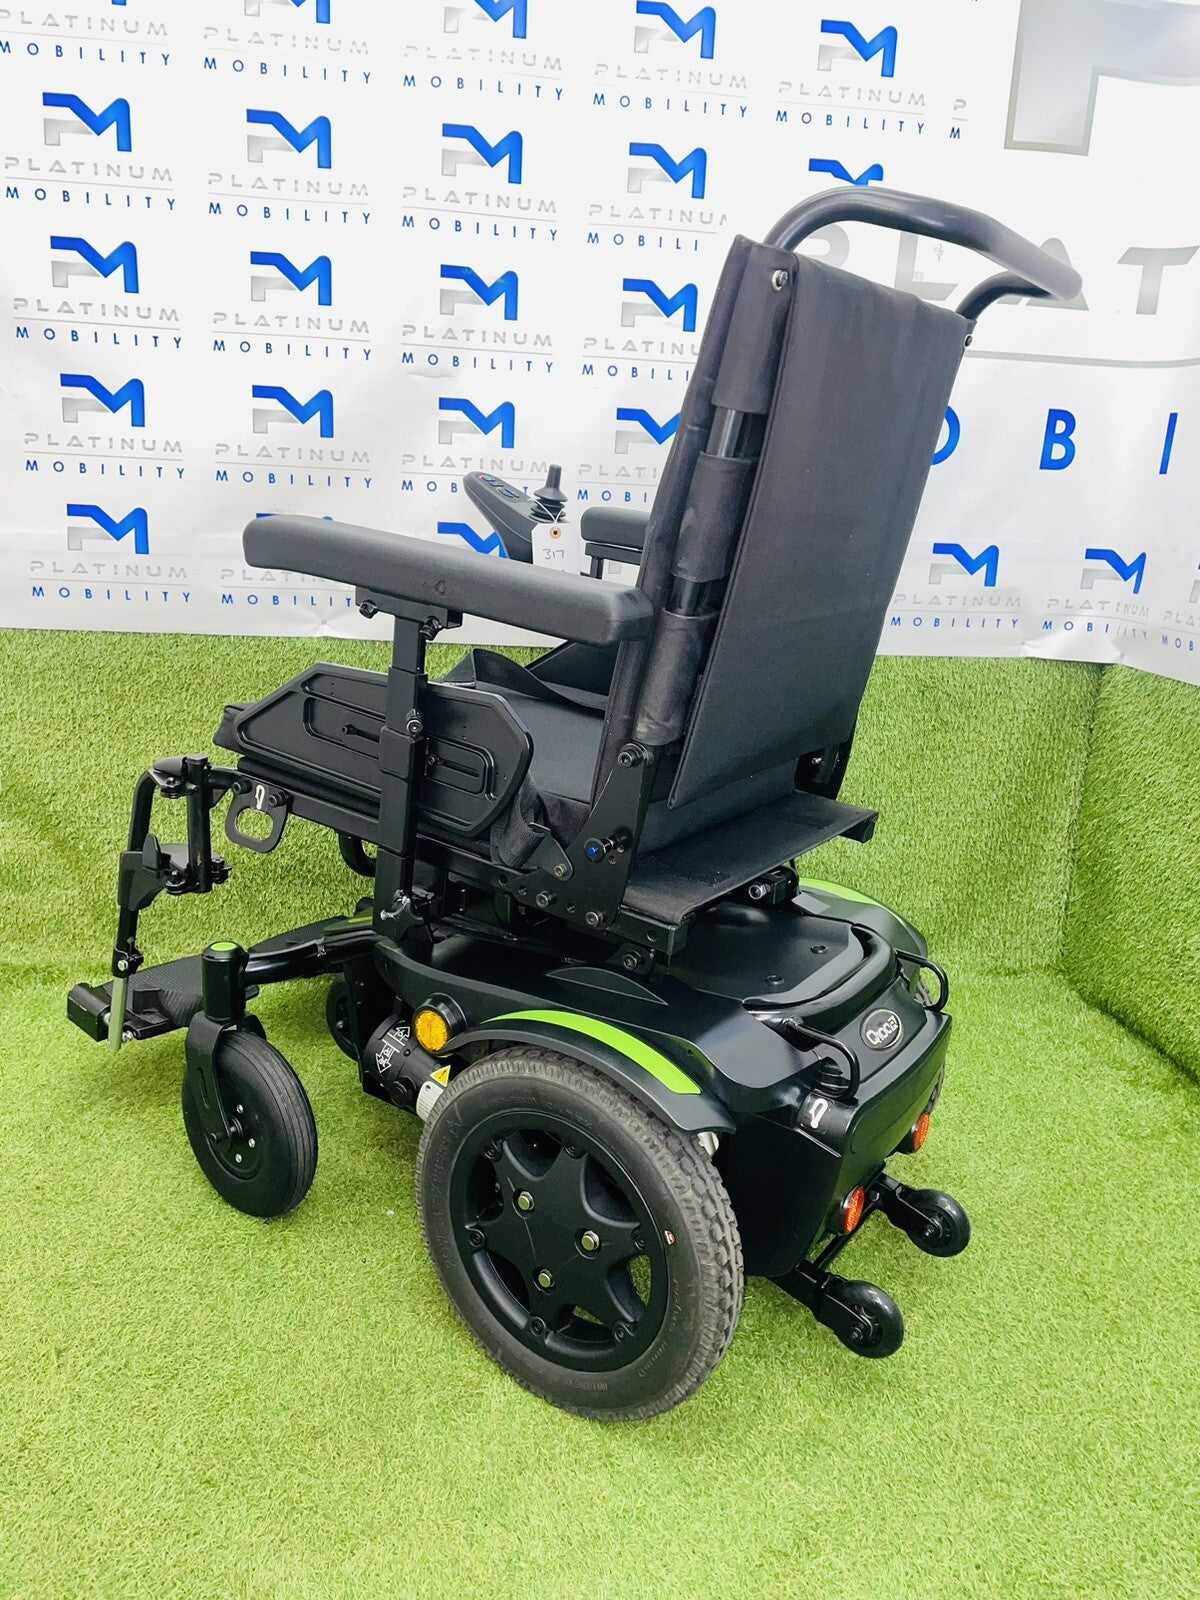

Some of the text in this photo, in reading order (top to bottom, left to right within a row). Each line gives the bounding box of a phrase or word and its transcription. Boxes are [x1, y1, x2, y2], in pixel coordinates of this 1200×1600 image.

[0, 9, 168, 36] PLATINUM
[203, 27, 370, 54] PLATINUM
[0, 41, 169, 66] MOBILITY
[404, 46, 562, 70] PLATINUM
[203, 57, 371, 84] MOBILITY
[595, 63, 747, 89] PLATINUM
[403, 75, 563, 100] MOBILITY
[778, 81, 925, 107] PLATINUM
[593, 93, 747, 118] MOBILITY
[776, 110, 924, 135] MOBILITY
[4, 156, 173, 182] PLATINUM
[208, 172, 369, 197] PLATINUM
[6, 186, 175, 211] MOBILITY
[402, 186, 557, 214] PLATINUM
[208, 202, 371, 225] MOBILITY
[402, 215, 558, 242] MOBILITY
[587, 232, 698, 252] MOBILI
[13, 297, 180, 322] PLATINUM
[212, 312, 370, 334] PLATINUM
[15, 326, 182, 349] MOBILITY
[401, 324, 552, 347] PLATINUM
[212, 339, 372, 361] MOBILITY
[401, 352, 554, 374] MOBILITY
[24, 432, 183, 453] PLATINUM
[215, 442, 371, 463] PLATINUM
[25, 459, 185, 480] MOBILITY
[401, 453, 548, 473] PLATINUM
[215, 469, 373, 489] MOBILITY
[542, 548, 566, 561] 317
[30, 560, 188, 578] PLATINUM
[31, 586, 191, 603] MOBILITY
[893, 594, 1022, 608] PLATINUM
[1046, 598, 1151, 618] PLATINUM
[1163, 610, 1200, 627] PLA
[890, 616, 1019, 629] MOBILITY
